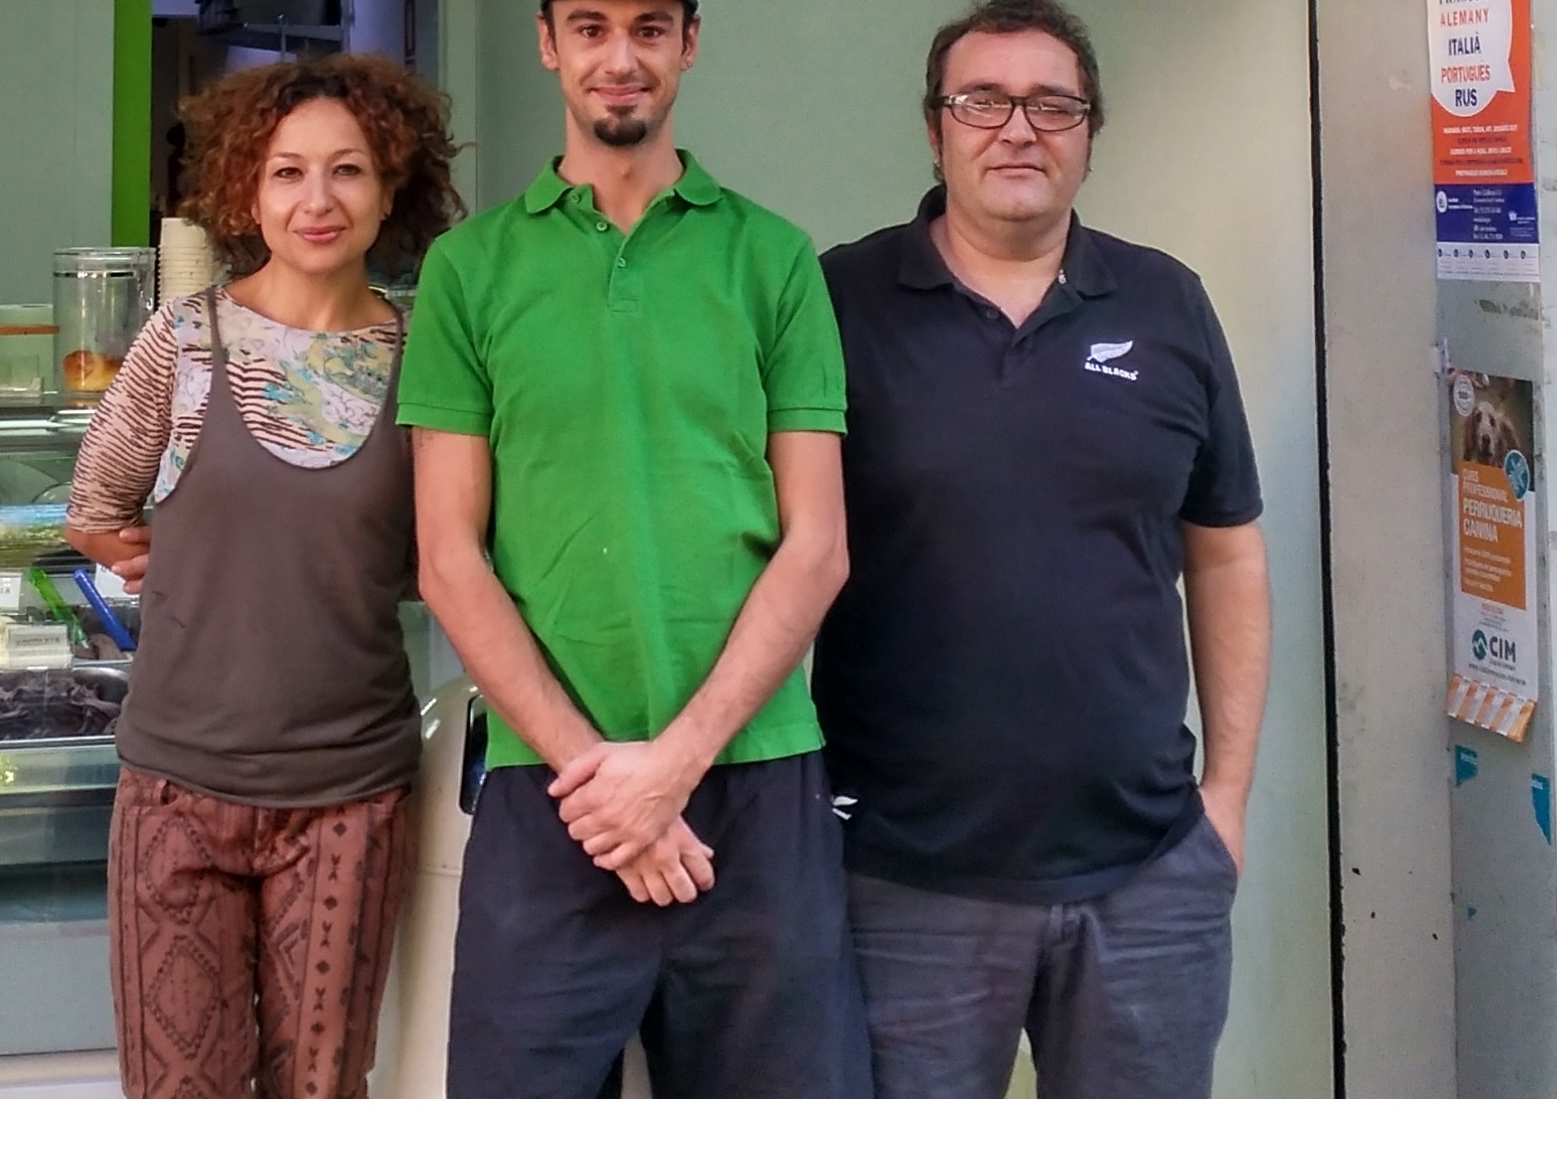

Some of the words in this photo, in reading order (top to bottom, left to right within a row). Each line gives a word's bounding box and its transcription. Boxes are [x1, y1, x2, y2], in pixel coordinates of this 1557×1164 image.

[1440, 8, 1489, 27] ALEMANY
[1448, 32, 1481, 56] ITALIÀ
[1455, 89, 1477, 107] RUS
[1084, 361, 1102, 372] ALL
[1489, 635, 1516, 663] CIM
